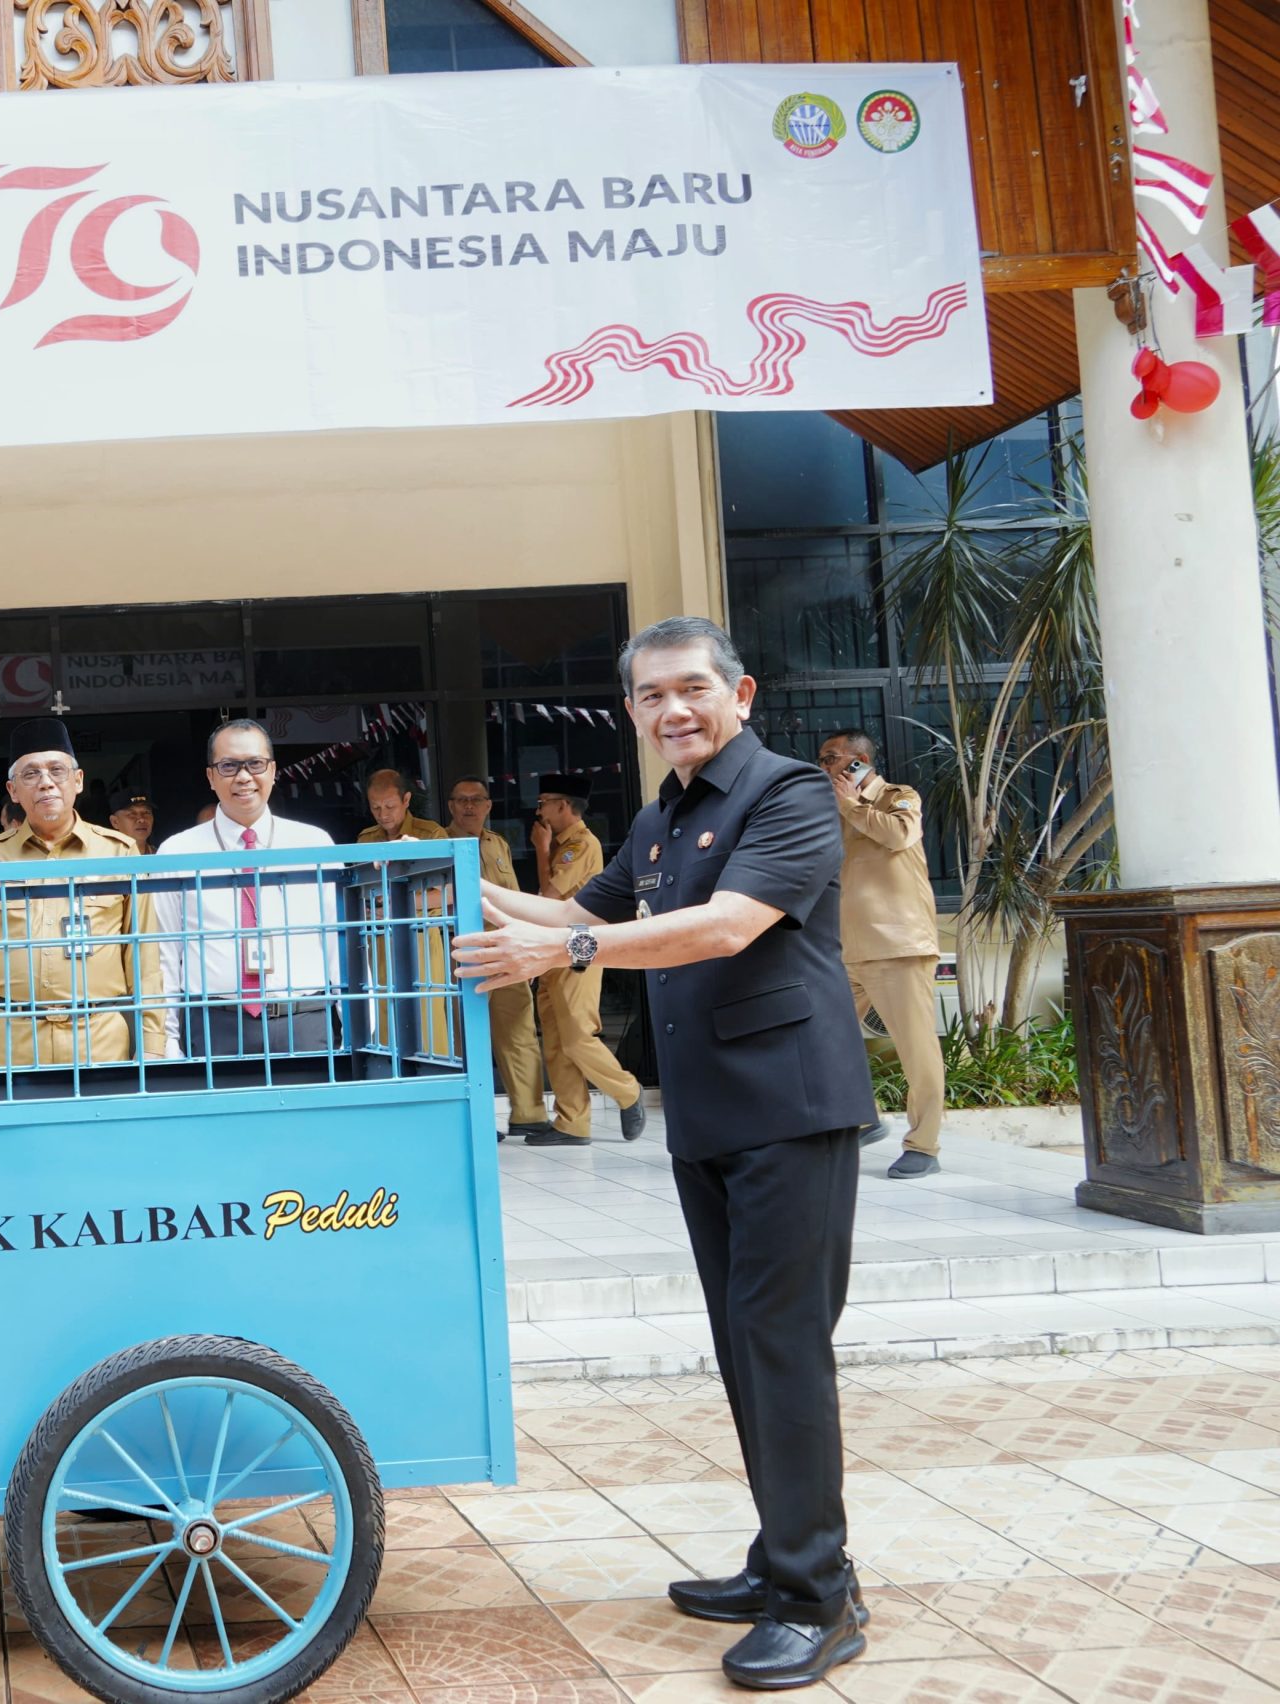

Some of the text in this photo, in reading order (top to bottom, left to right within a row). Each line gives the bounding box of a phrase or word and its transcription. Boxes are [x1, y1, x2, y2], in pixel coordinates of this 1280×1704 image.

[233, 172, 753, 225] NUSANTARA BARU
[236, 223, 727, 277] INDONESIA MAJU
[28, 1201, 257, 1249] KALBAR
[262, 1187, 399, 1240] Peduli
